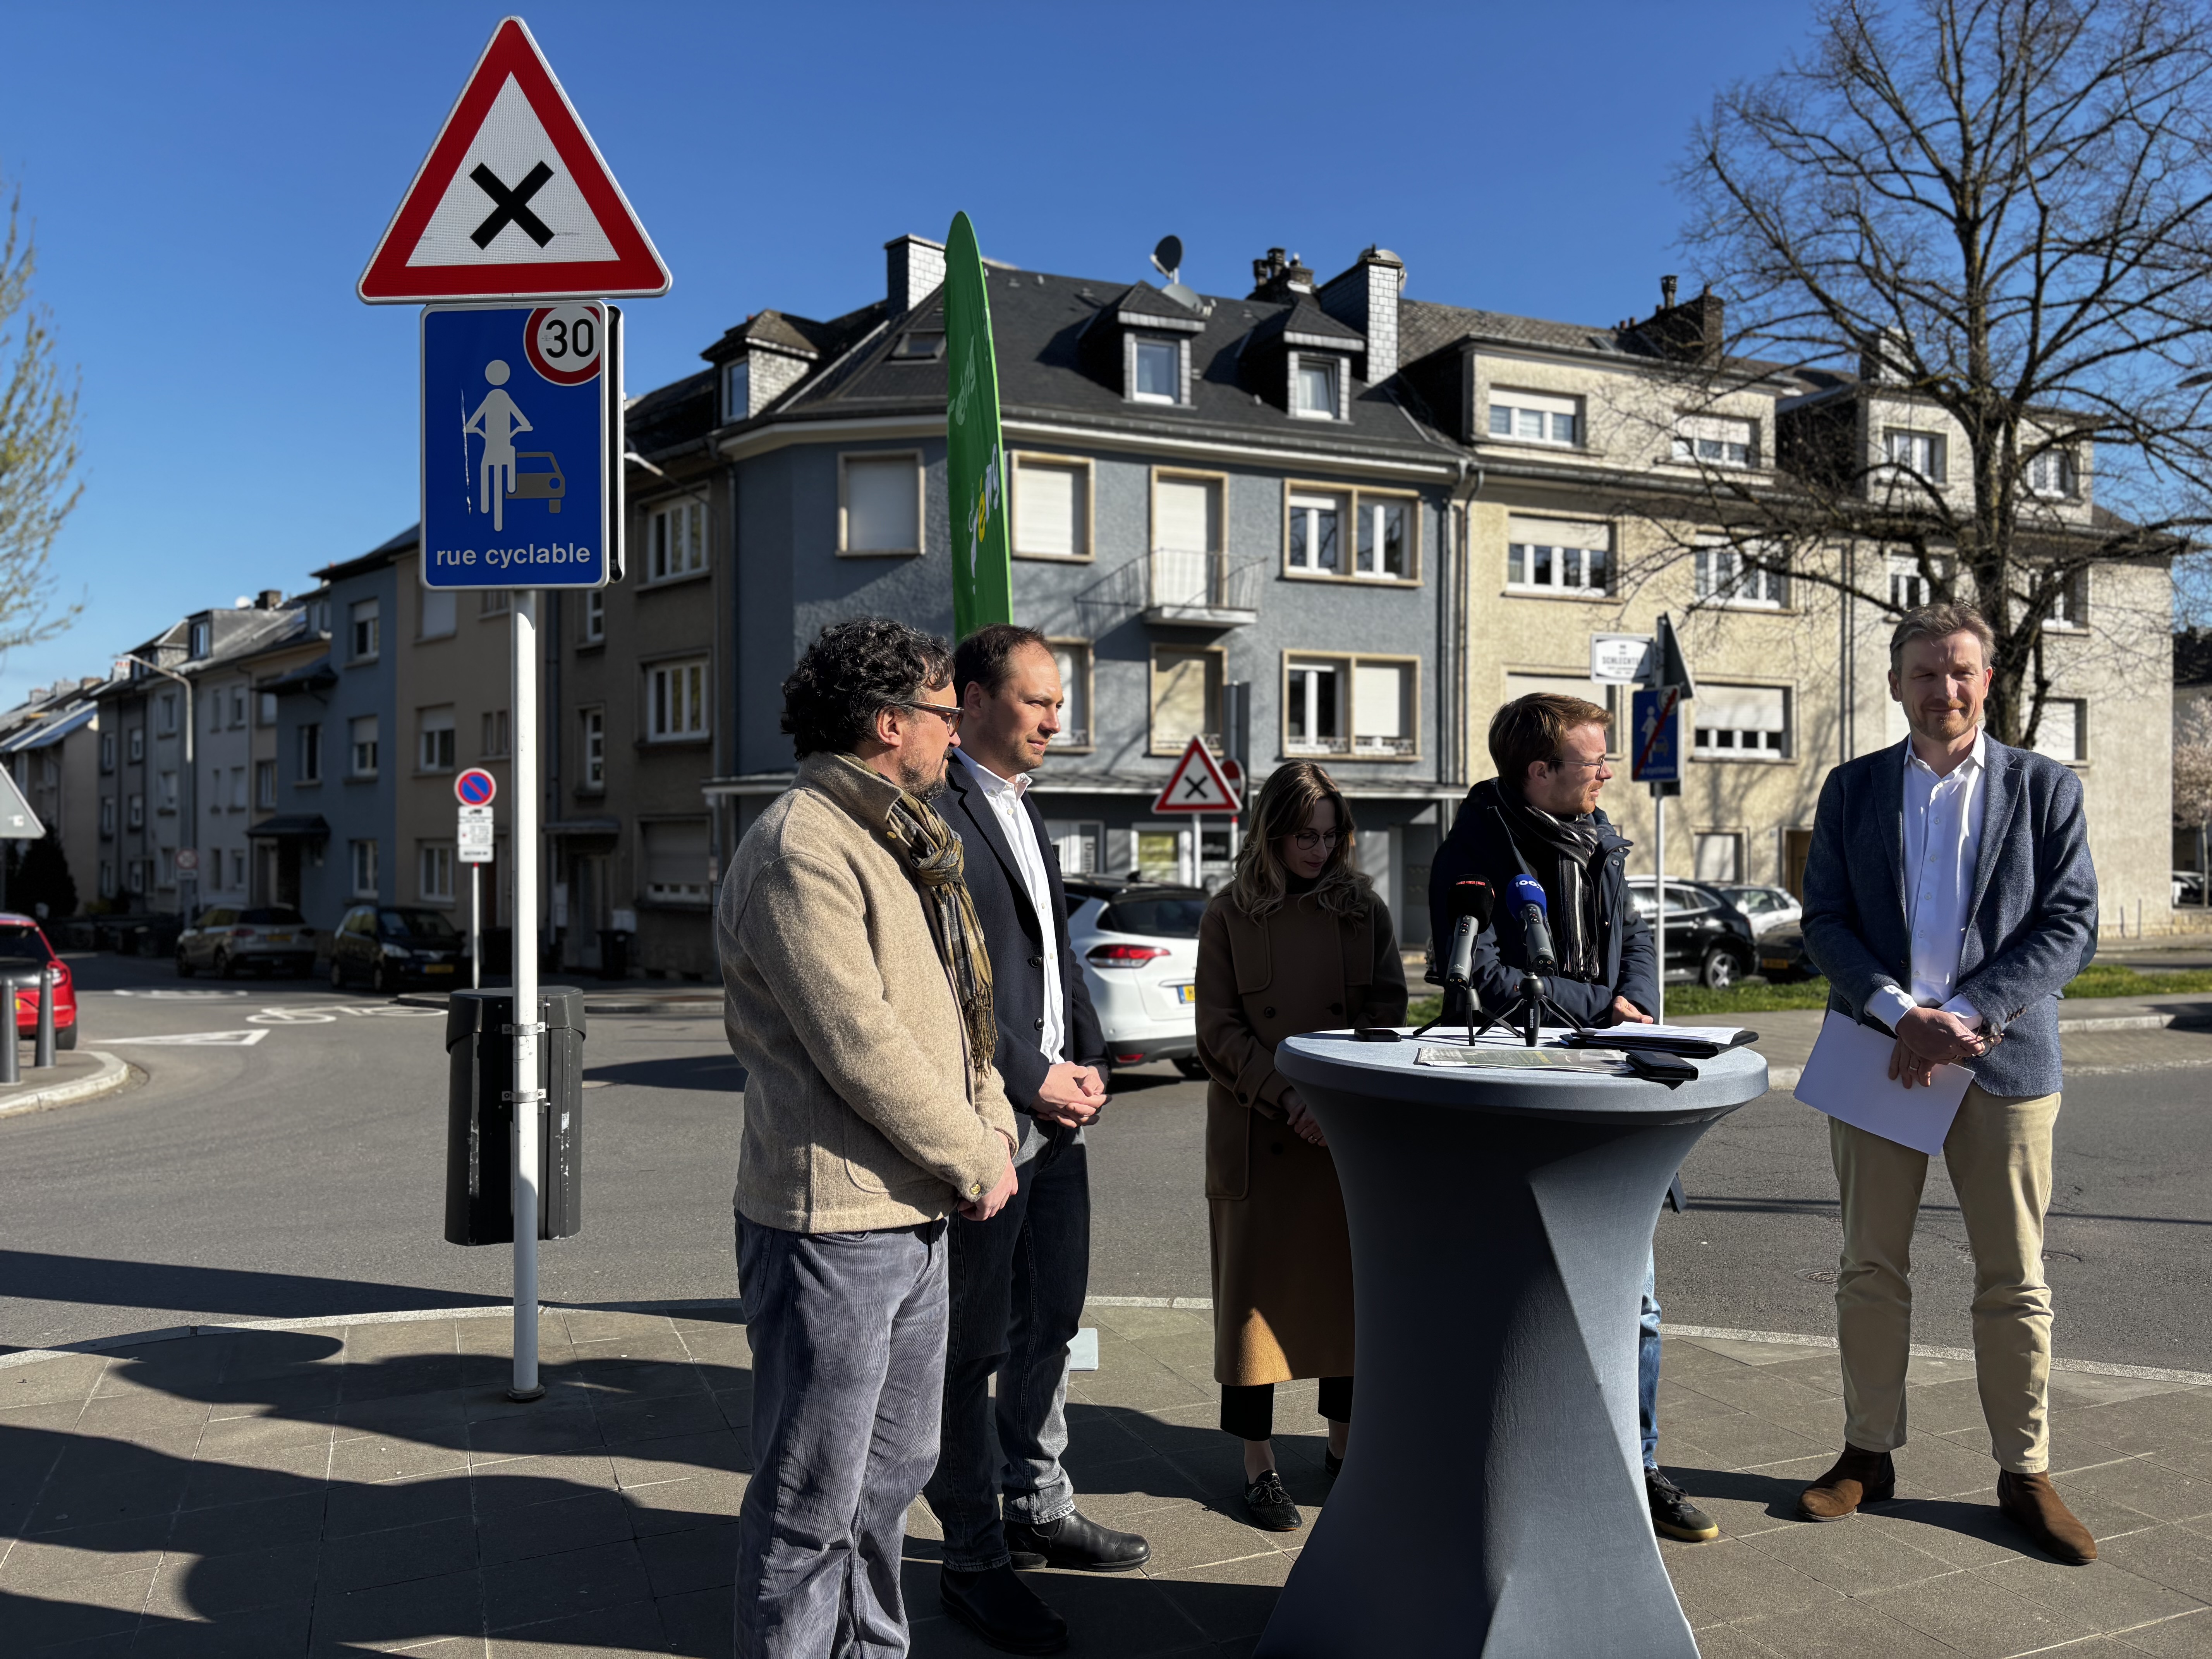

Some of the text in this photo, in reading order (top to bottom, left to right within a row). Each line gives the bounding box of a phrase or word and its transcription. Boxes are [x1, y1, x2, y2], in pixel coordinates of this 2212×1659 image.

[545, 318, 594, 358] 30
[437, 549, 477, 565] rue
[485, 543, 591, 568] cyclable
